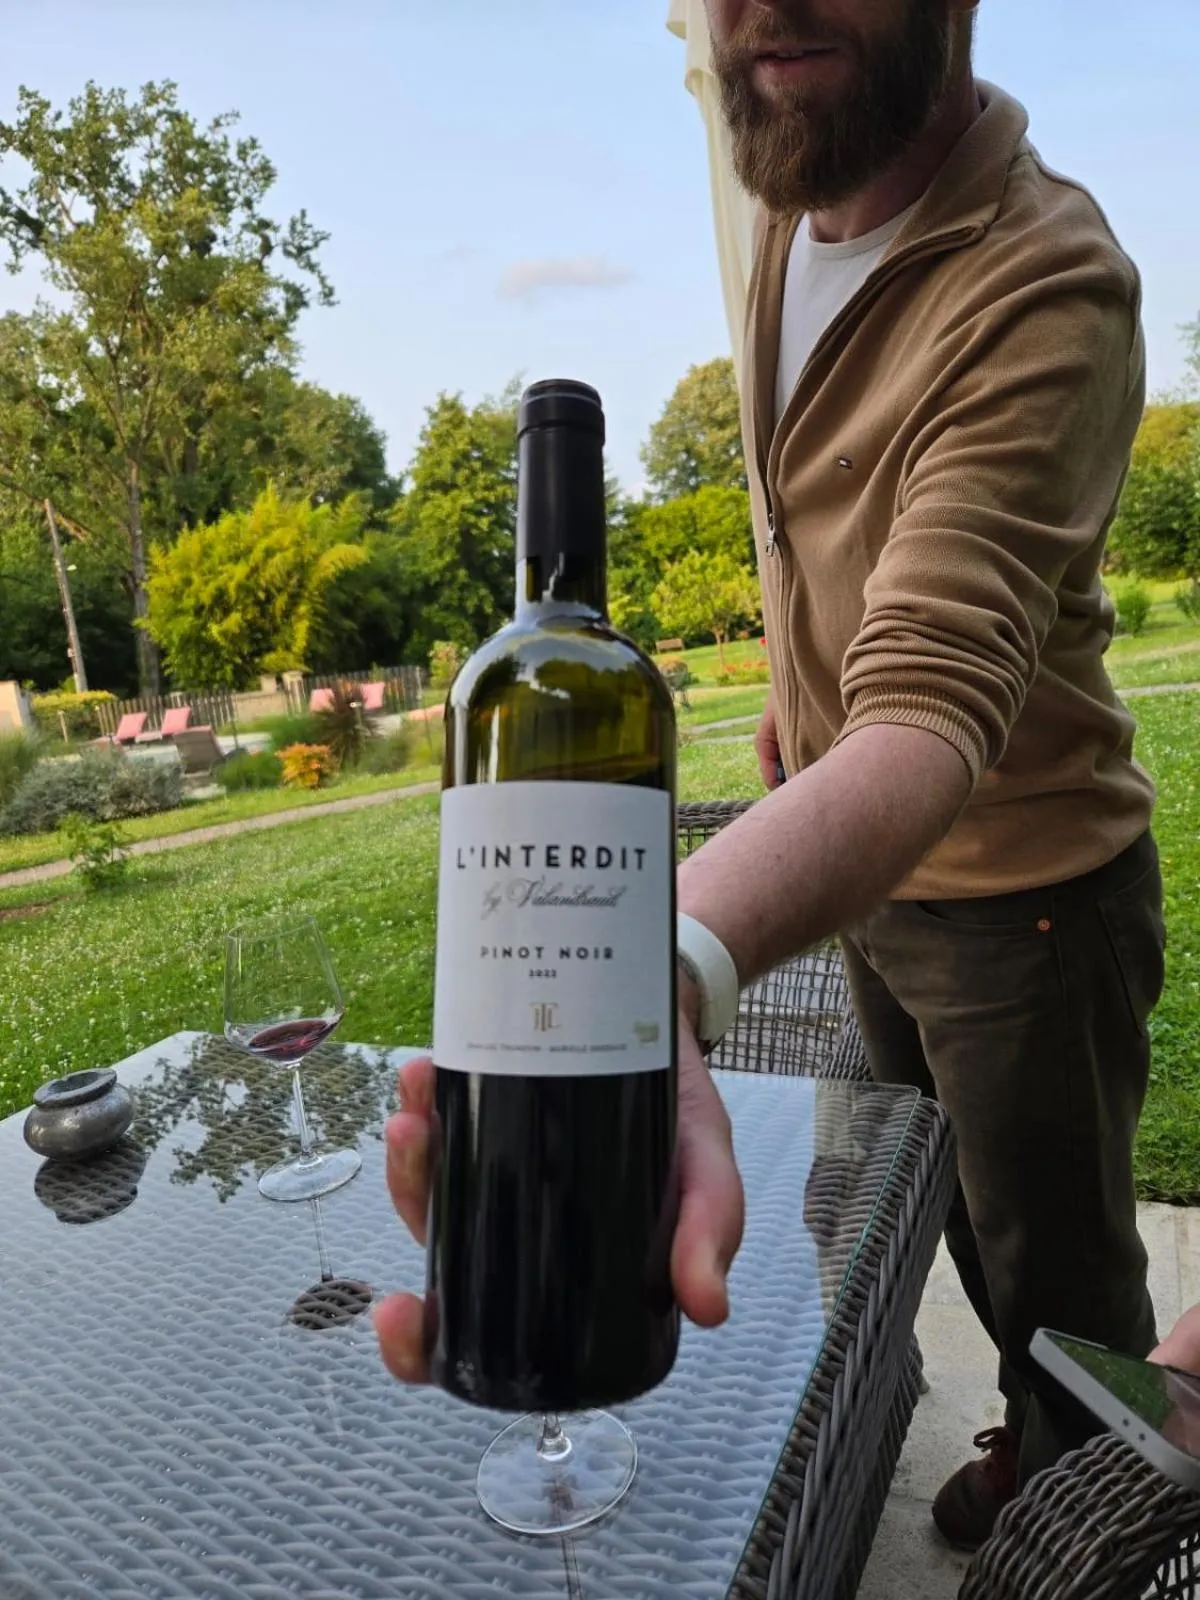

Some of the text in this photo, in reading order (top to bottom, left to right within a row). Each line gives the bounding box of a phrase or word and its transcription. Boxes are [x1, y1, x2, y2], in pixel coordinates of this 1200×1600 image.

[456, 844, 647, 871] L'INTERDIT
[480, 945, 614, 961] PINOT NOIR
